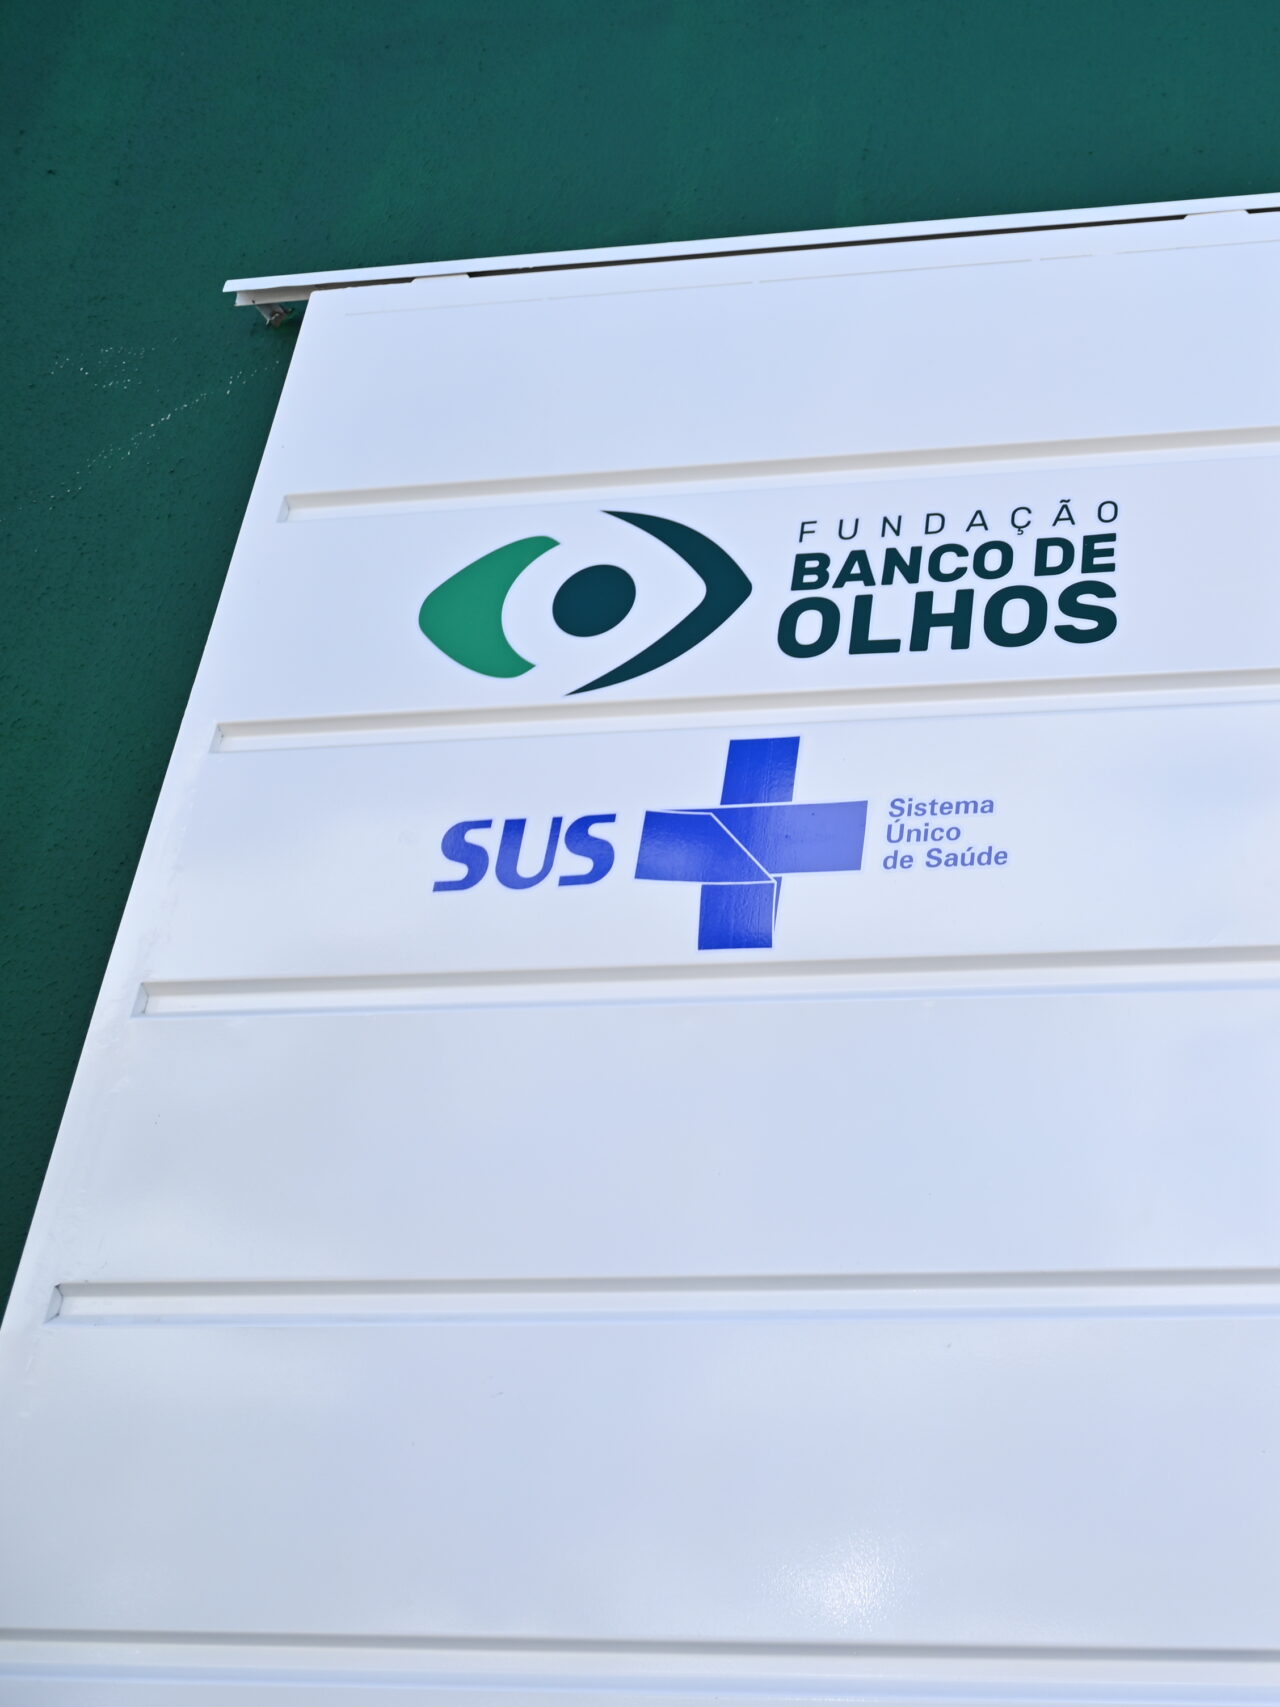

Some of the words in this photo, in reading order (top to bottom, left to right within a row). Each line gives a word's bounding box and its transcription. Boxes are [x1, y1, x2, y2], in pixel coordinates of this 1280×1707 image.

[798, 499, 1119, 543] FUNDAÇÃO
[789, 538, 1014, 592] BANCO
[1033, 532, 1117, 577] DE
[776, 580, 1118, 660] OLHOS
[888, 797, 995, 818] Sistema
[432, 812, 617, 893] SUS
[886, 818, 961, 844] Único
[882, 849, 914, 870] de
[925, 845, 1008, 868] Saúde
